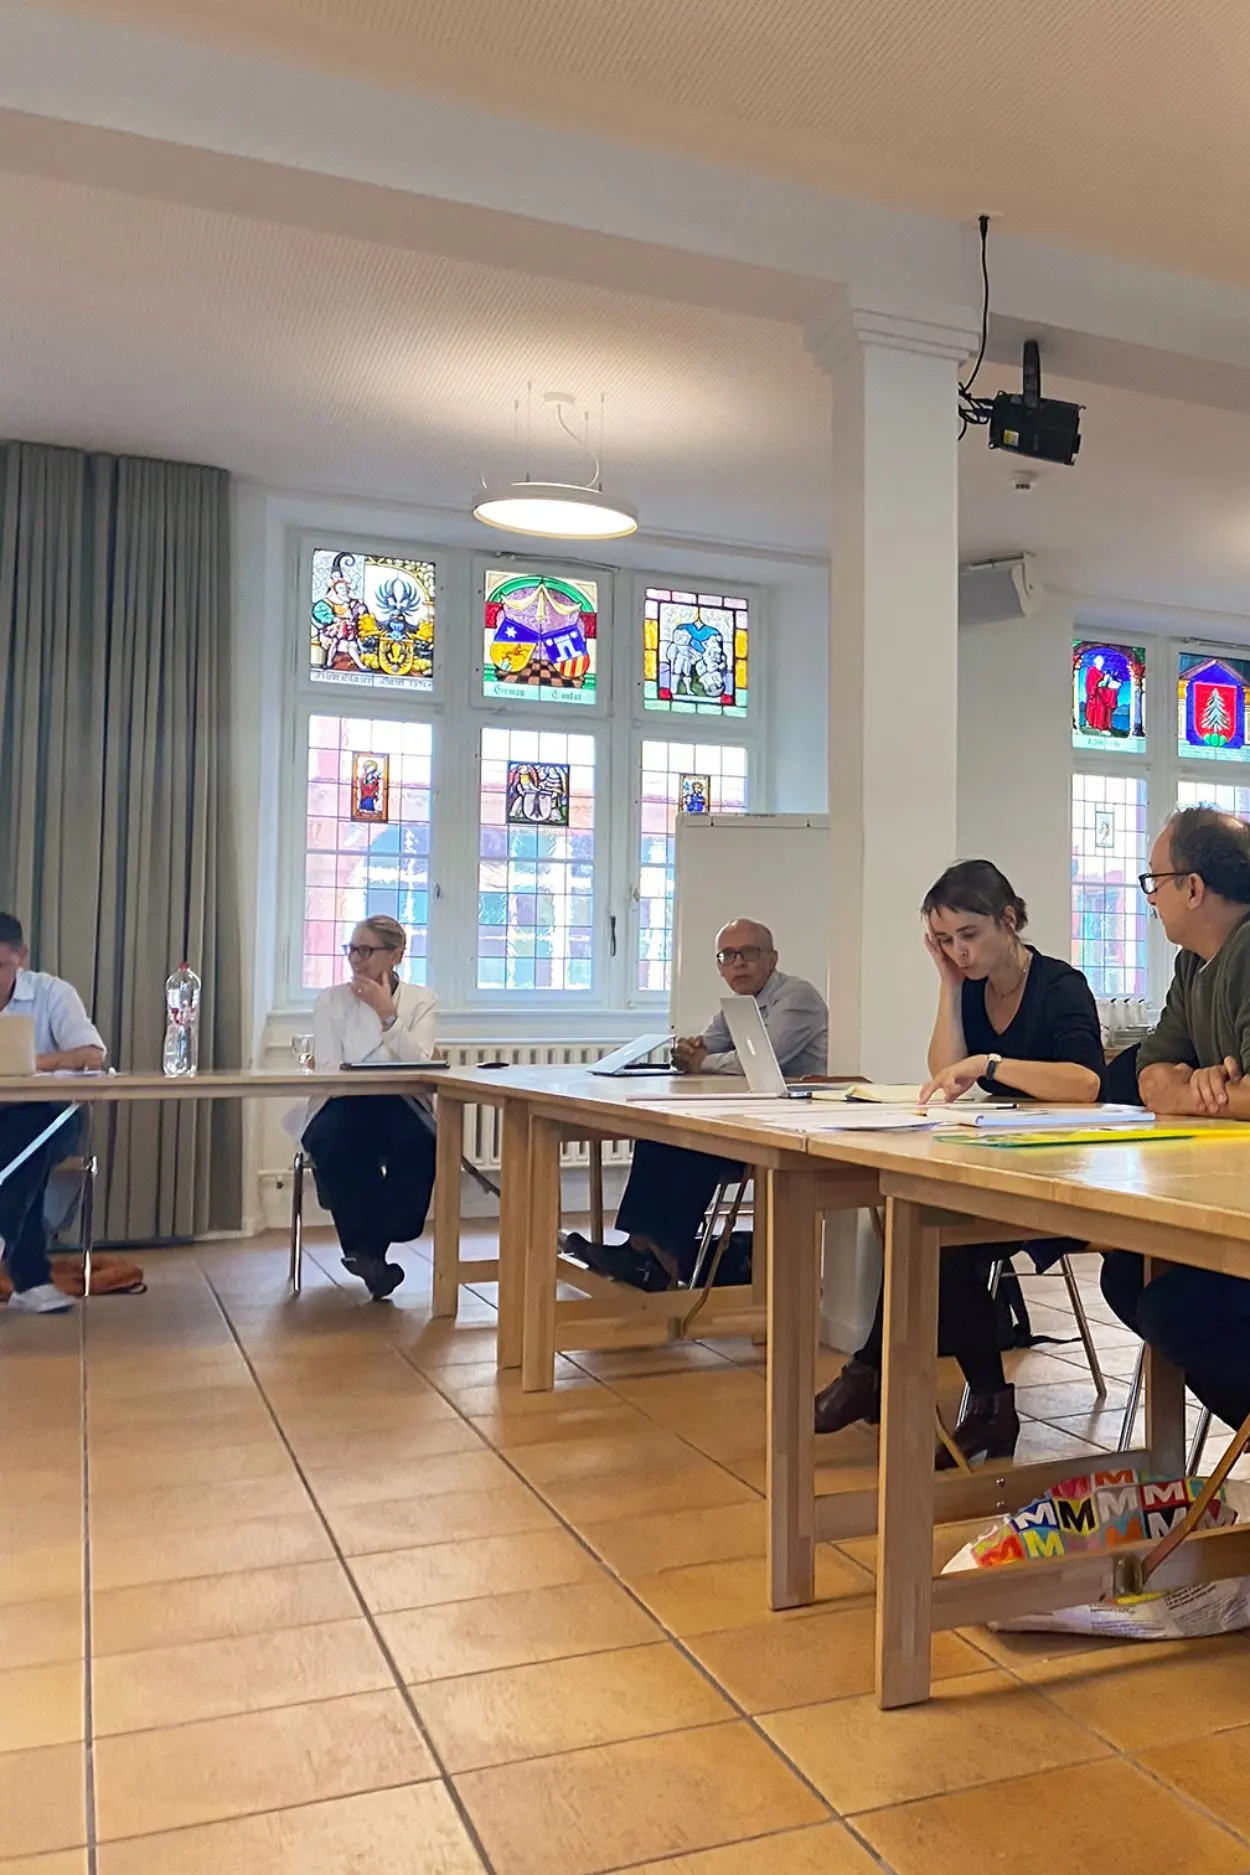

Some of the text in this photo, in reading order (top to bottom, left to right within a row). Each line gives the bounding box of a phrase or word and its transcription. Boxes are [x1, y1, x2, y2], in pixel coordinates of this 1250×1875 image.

[1144, 1482, 1185, 1506] M
[1014, 1502, 1057, 1530] M
[1057, 1497, 1096, 1533] M
[1022, 1530, 1065, 1558] M
